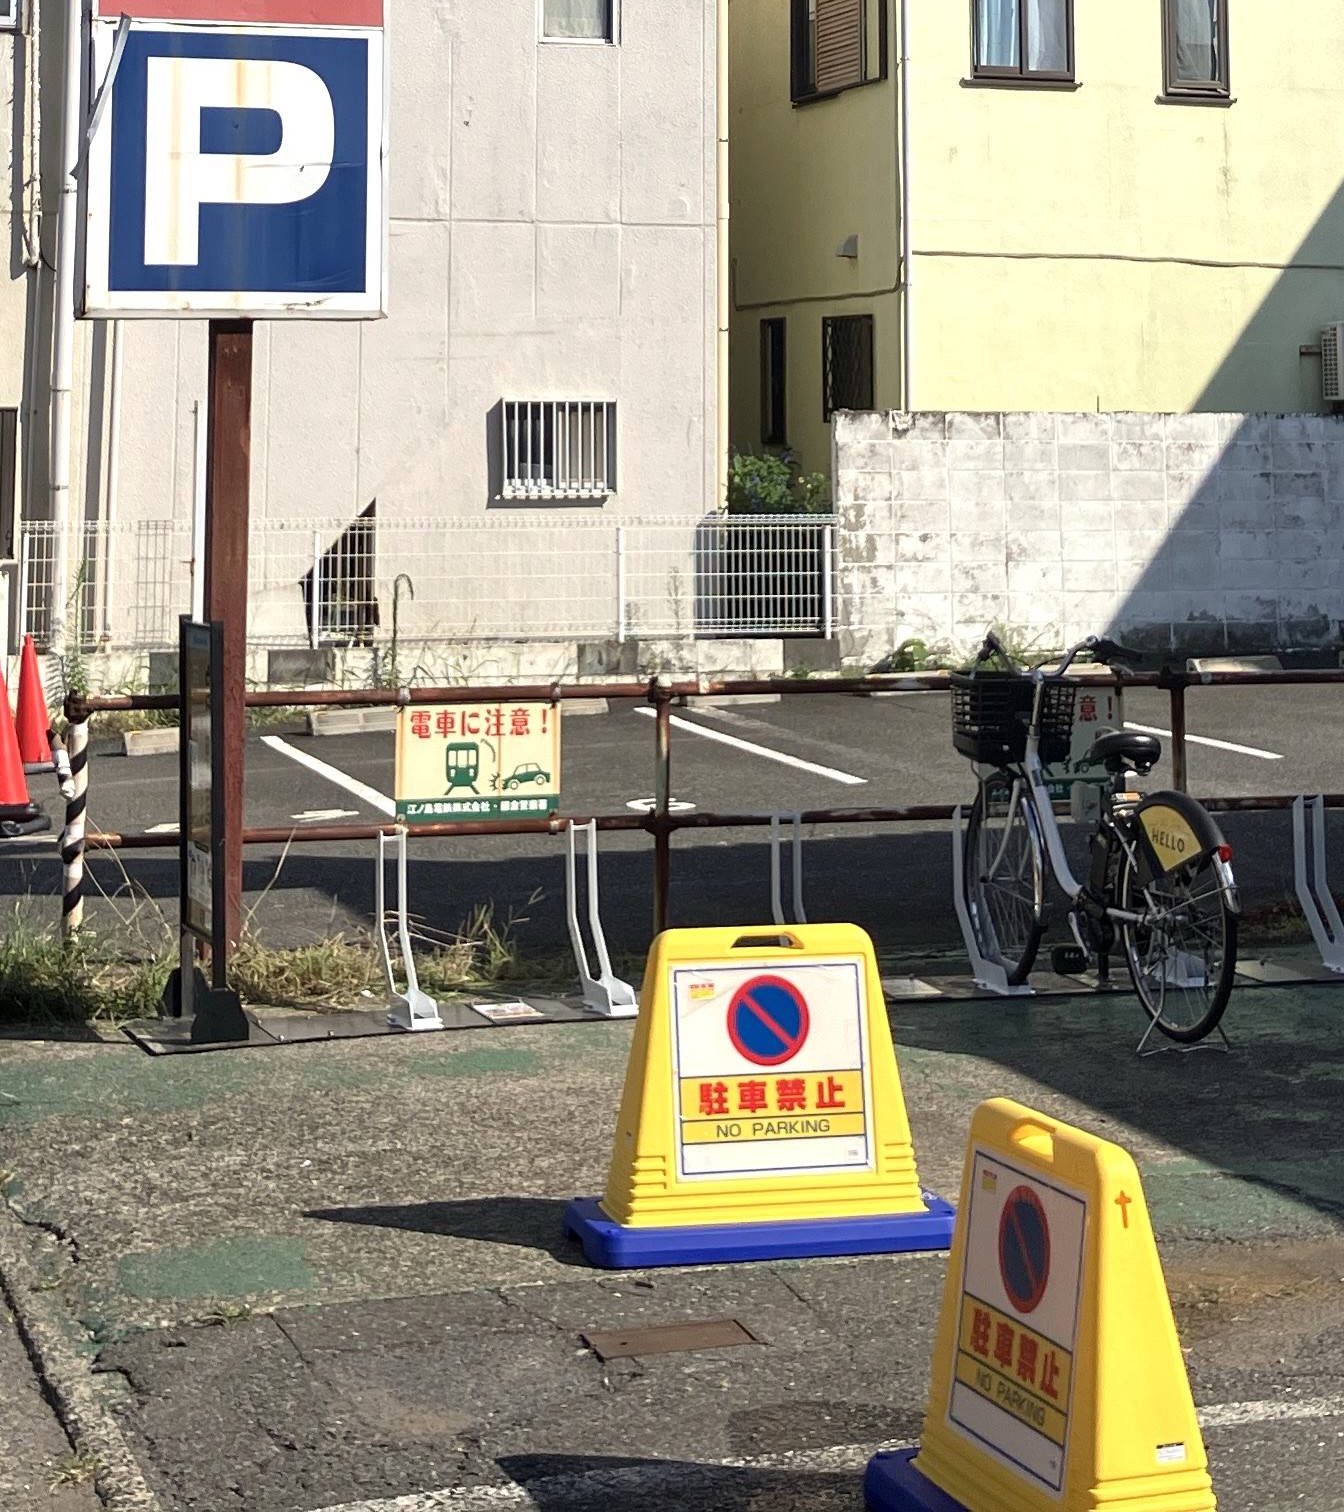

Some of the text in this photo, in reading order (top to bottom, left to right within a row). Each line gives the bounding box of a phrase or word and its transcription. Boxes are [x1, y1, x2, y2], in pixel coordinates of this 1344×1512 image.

[144, 56, 335, 266] P
[1152, 828, 1185, 854] HELLO
[699, 1076, 845, 1115] 駐車禁止
[716, 1119, 830, 1137] NO PARKING
[970, 1307, 1060, 1400] 駐車禁止
[976, 1367, 1045, 1427] NO PARKING
